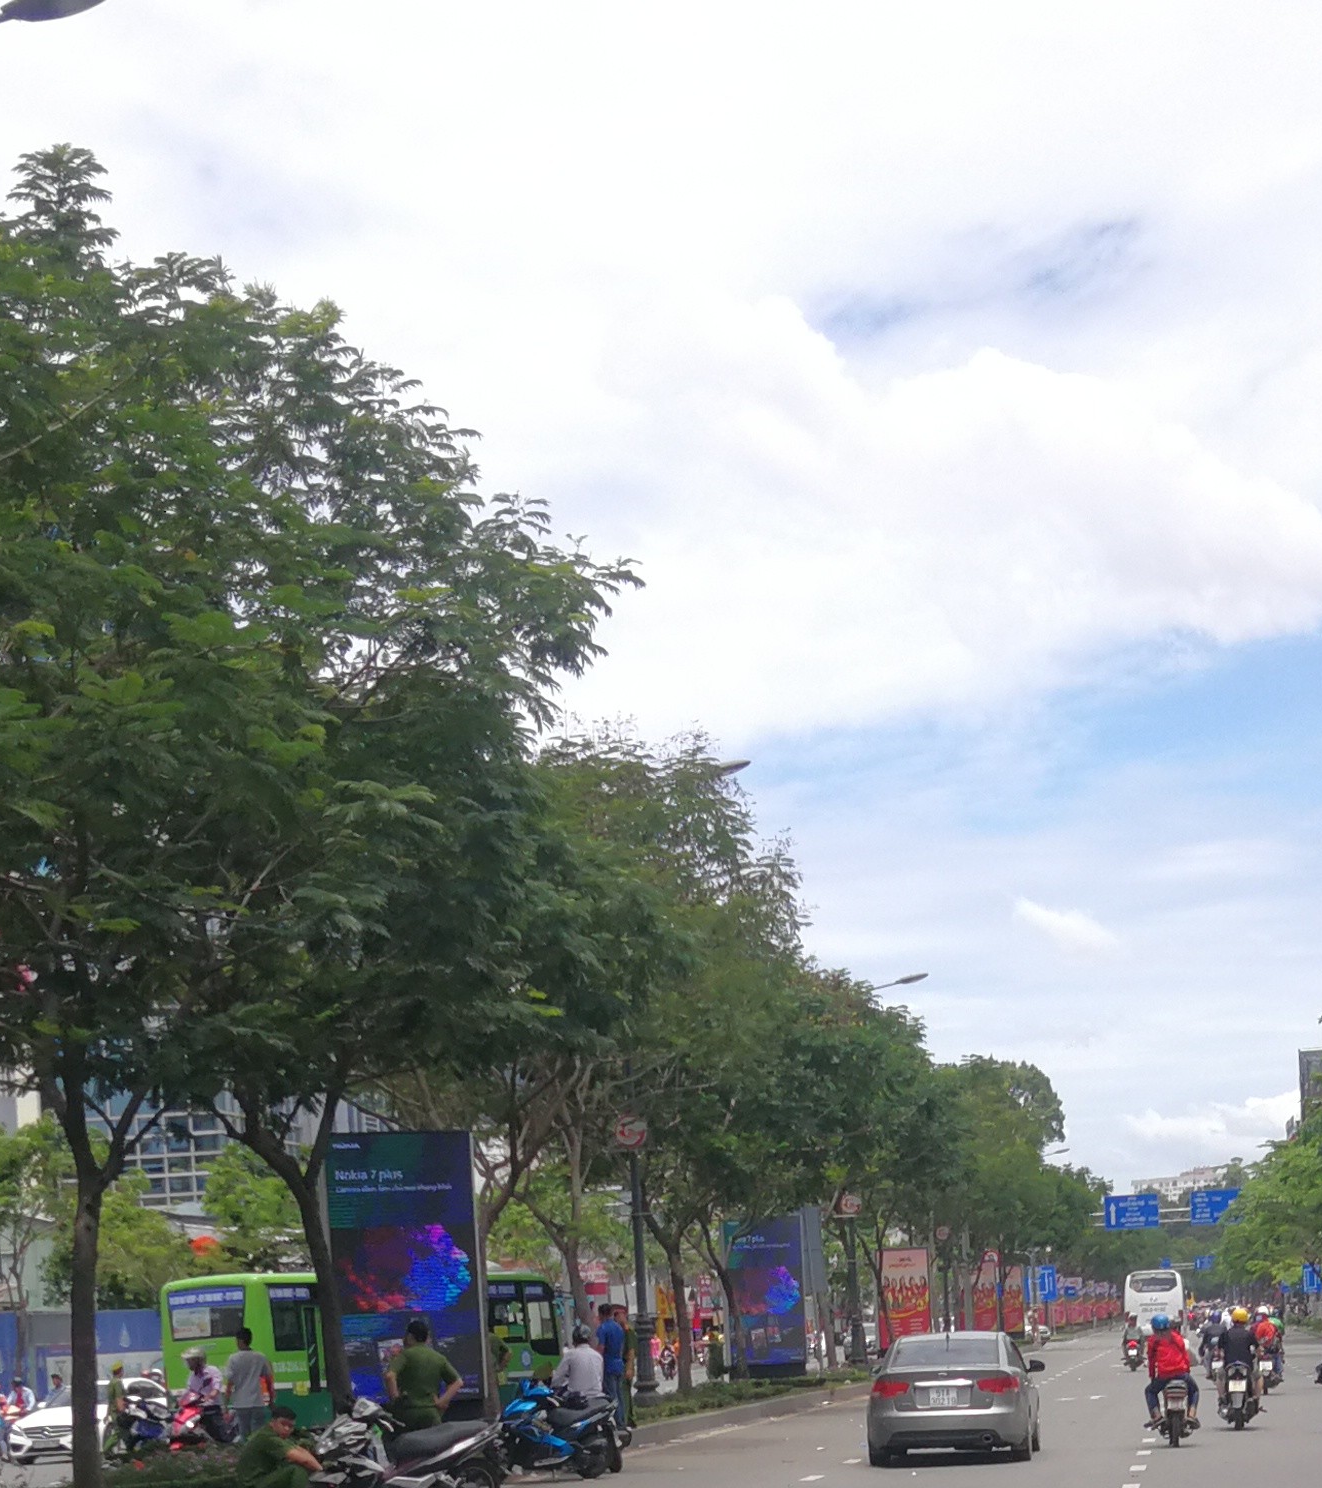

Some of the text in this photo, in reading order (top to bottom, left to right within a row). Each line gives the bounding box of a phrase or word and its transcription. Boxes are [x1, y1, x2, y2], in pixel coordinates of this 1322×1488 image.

[335, 1169, 403, 1182] Nokia 7 plus
